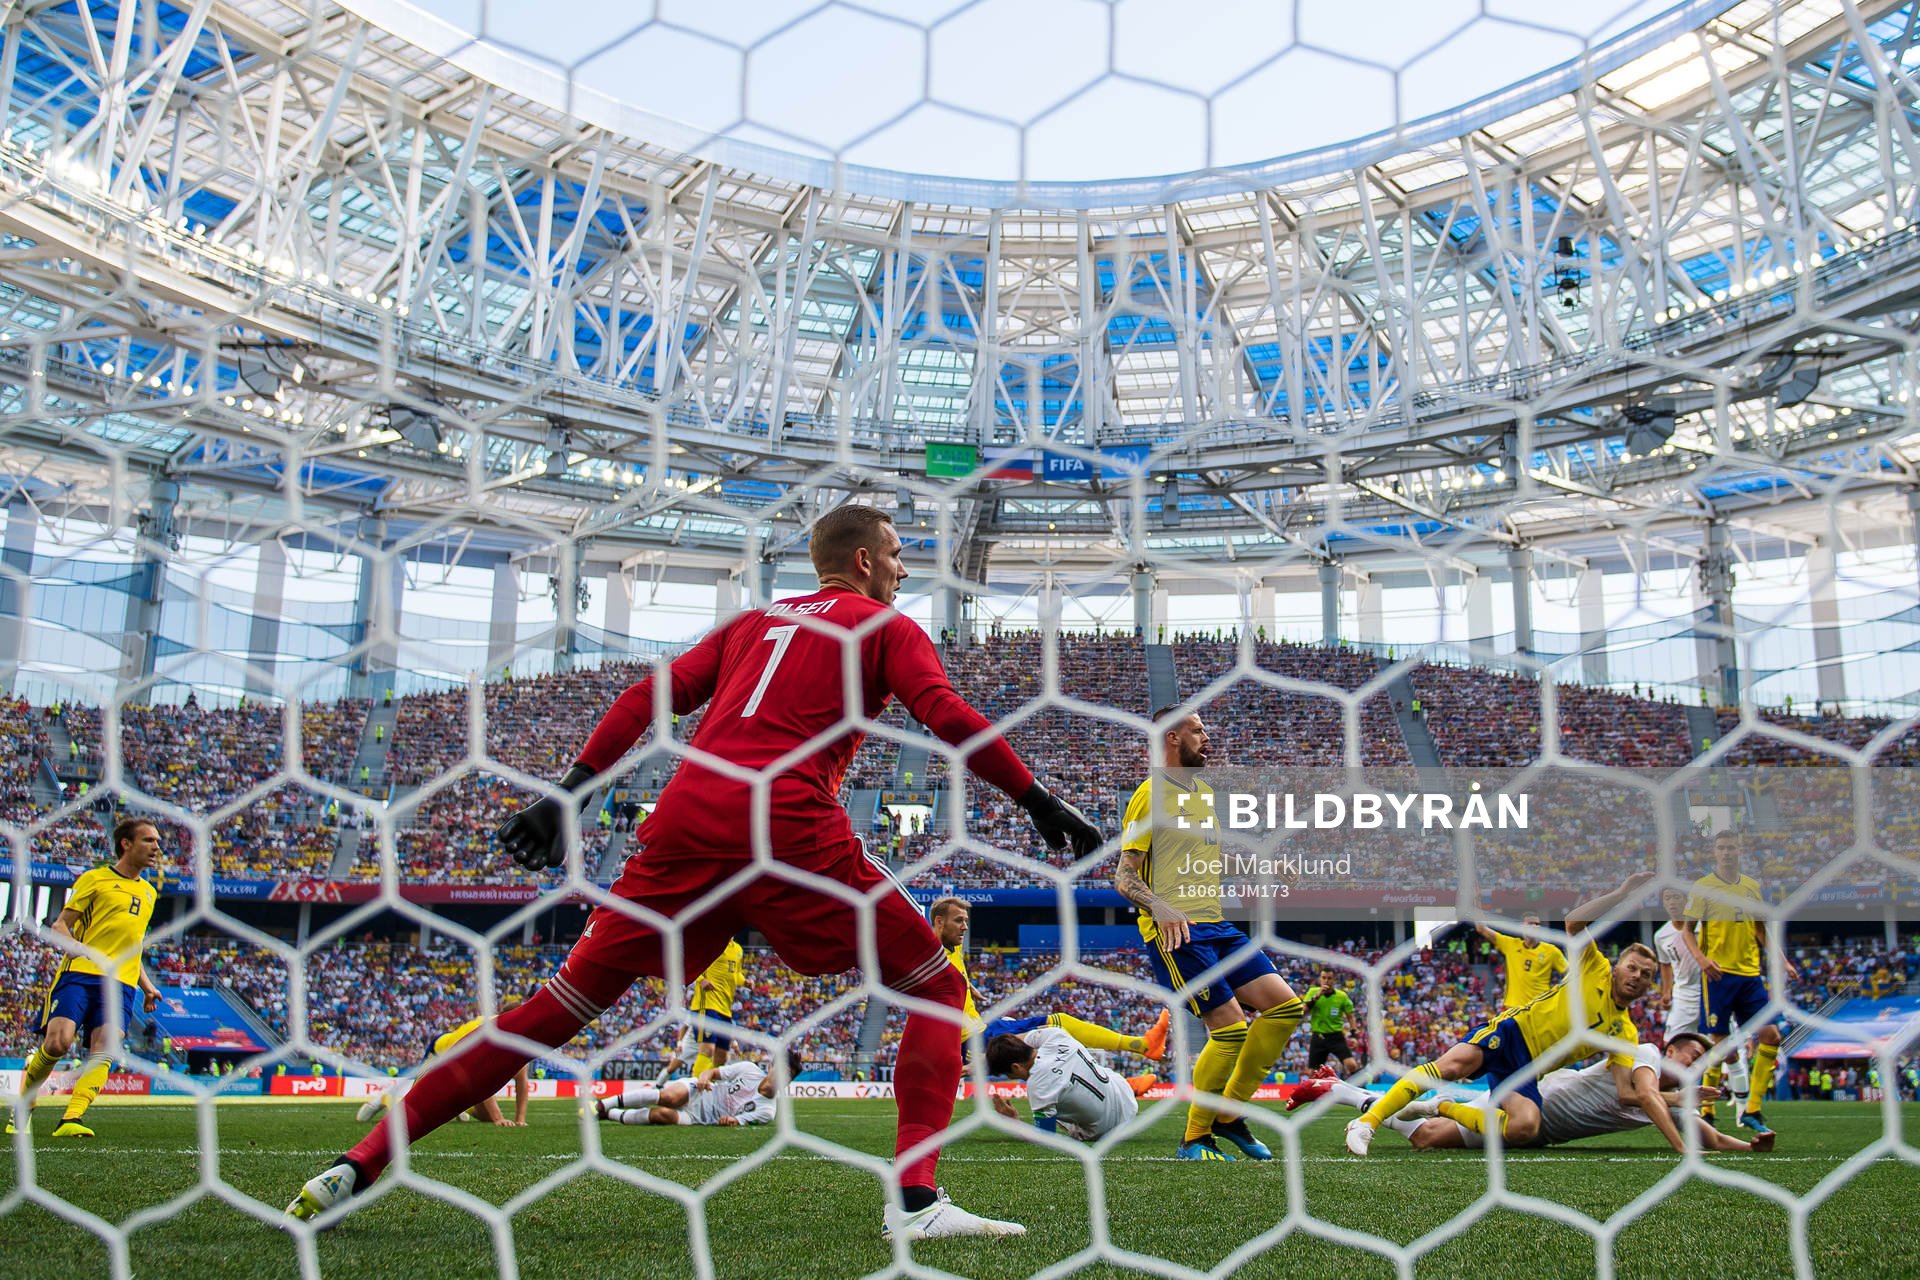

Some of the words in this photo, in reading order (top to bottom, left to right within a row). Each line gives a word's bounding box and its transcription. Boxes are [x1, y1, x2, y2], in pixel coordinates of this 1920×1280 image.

[1050, 458, 1085, 472] FIFA
[740, 624, 800, 718] 1
[129, 895, 141, 916] 8
[1382, 893, 1437, 905] #worldcup
[786, 1086, 838, 1097] LROSA
